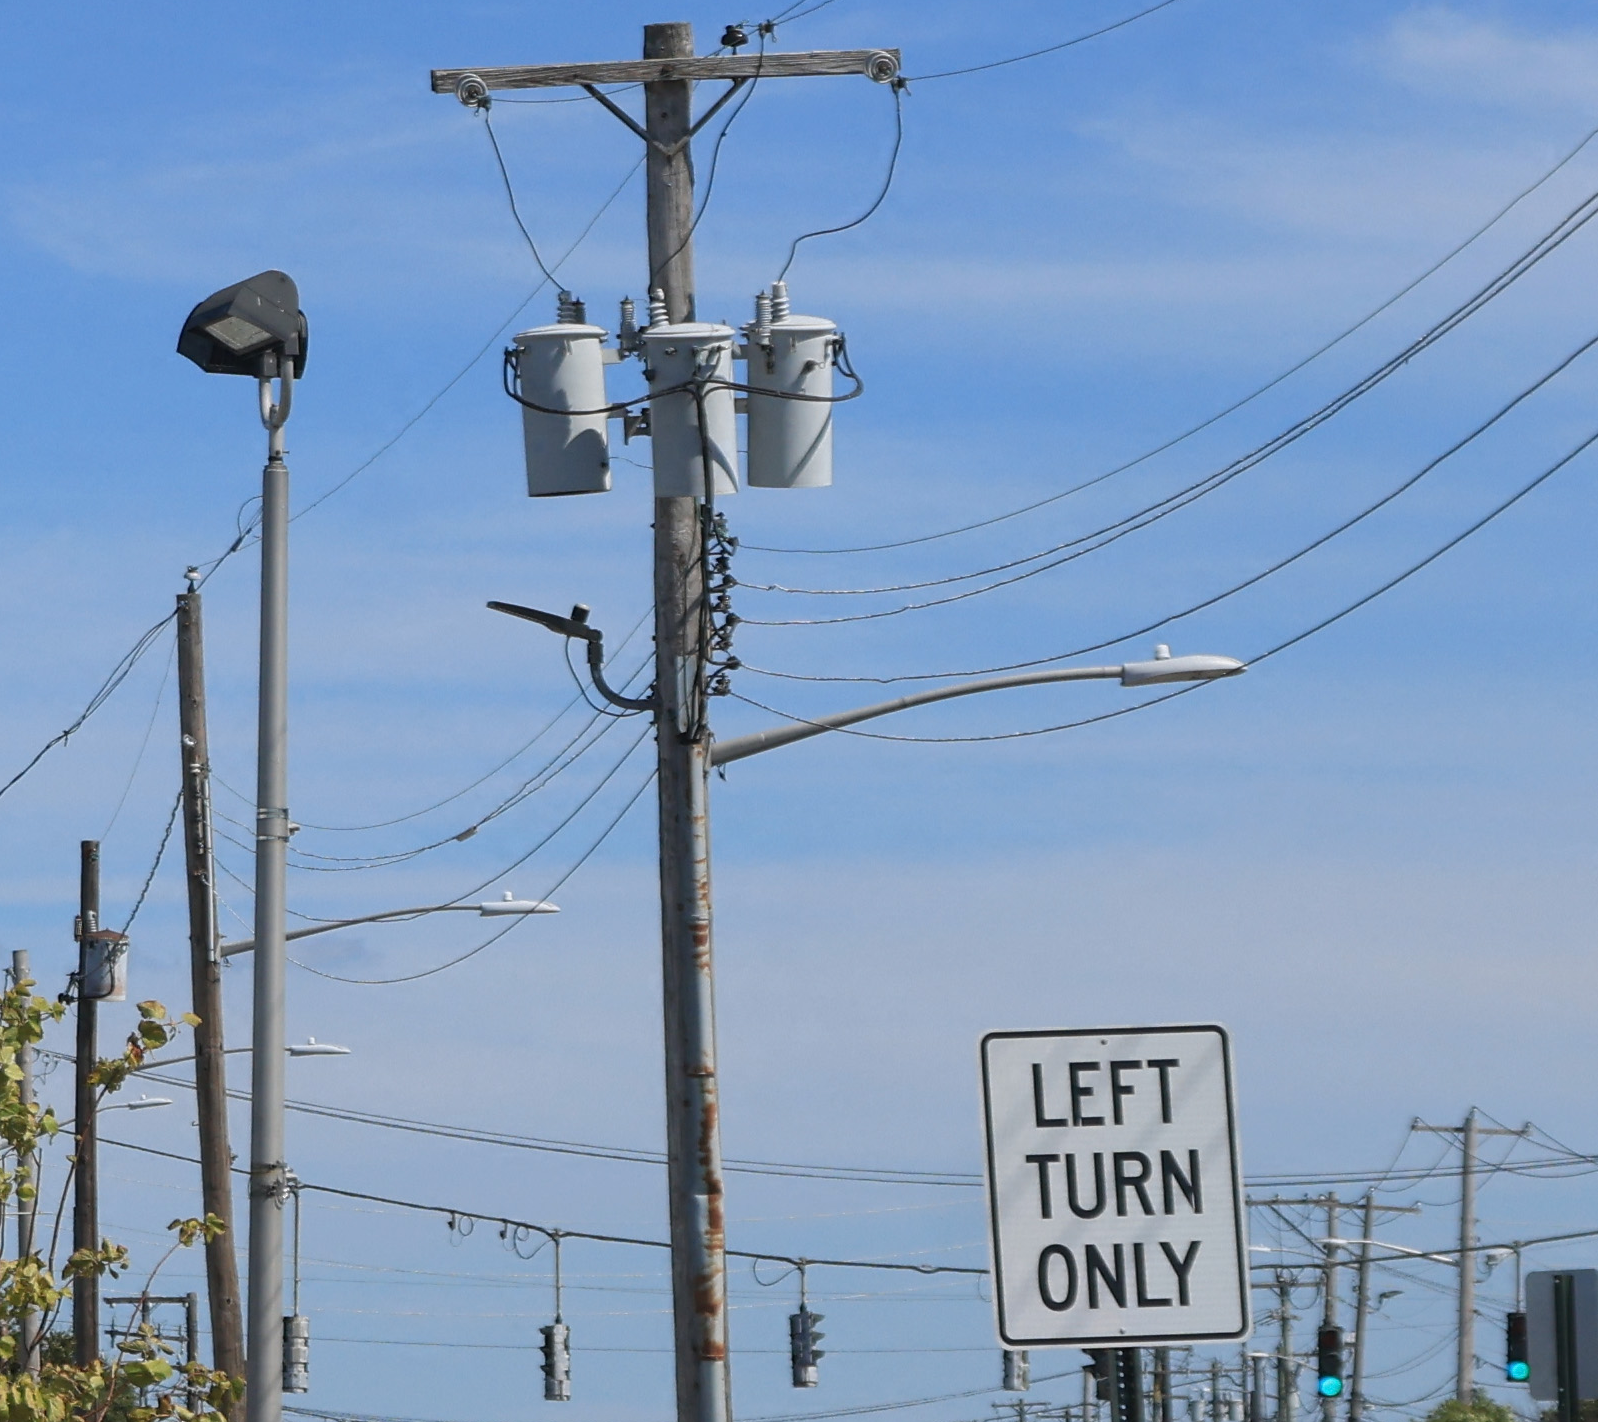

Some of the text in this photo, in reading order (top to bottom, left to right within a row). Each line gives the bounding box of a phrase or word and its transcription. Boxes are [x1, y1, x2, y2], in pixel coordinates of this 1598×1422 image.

[1032, 1059, 1180, 1128] LEFT
[1026, 1149, 1204, 1219] TURN
[1038, 1240, 1202, 1312] ONLY
